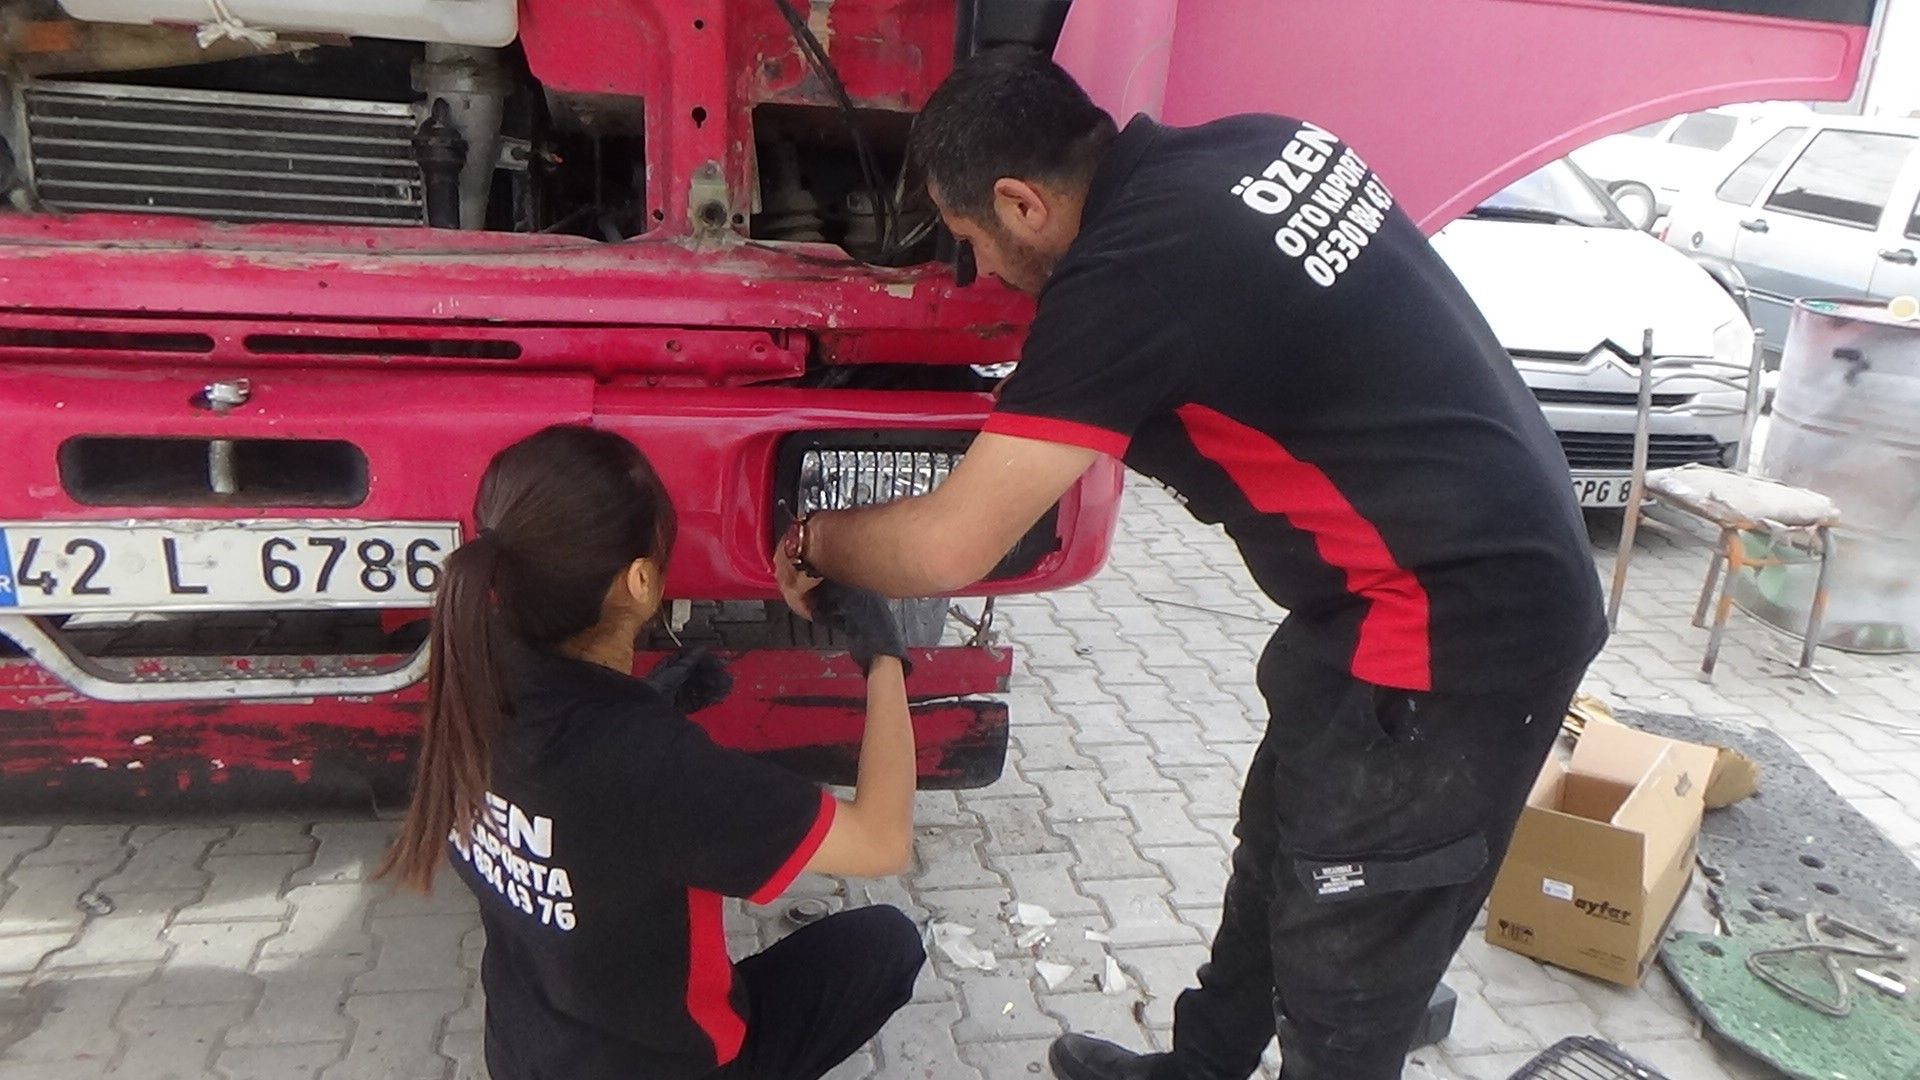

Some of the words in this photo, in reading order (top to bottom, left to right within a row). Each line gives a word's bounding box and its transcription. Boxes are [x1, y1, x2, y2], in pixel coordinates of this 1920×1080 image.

[1230, 120, 1339, 214] ÖZEN
[1275, 203, 1331, 257] OTO
[1304, 219, 1369, 287] 0530
[17, 537, 111, 595] 42
[161, 537, 208, 594] L
[261, 537, 442, 593] 6786
[484, 790, 553, 858] EN
[507, 879, 534, 915] 43
[537, 895, 577, 931] 76
